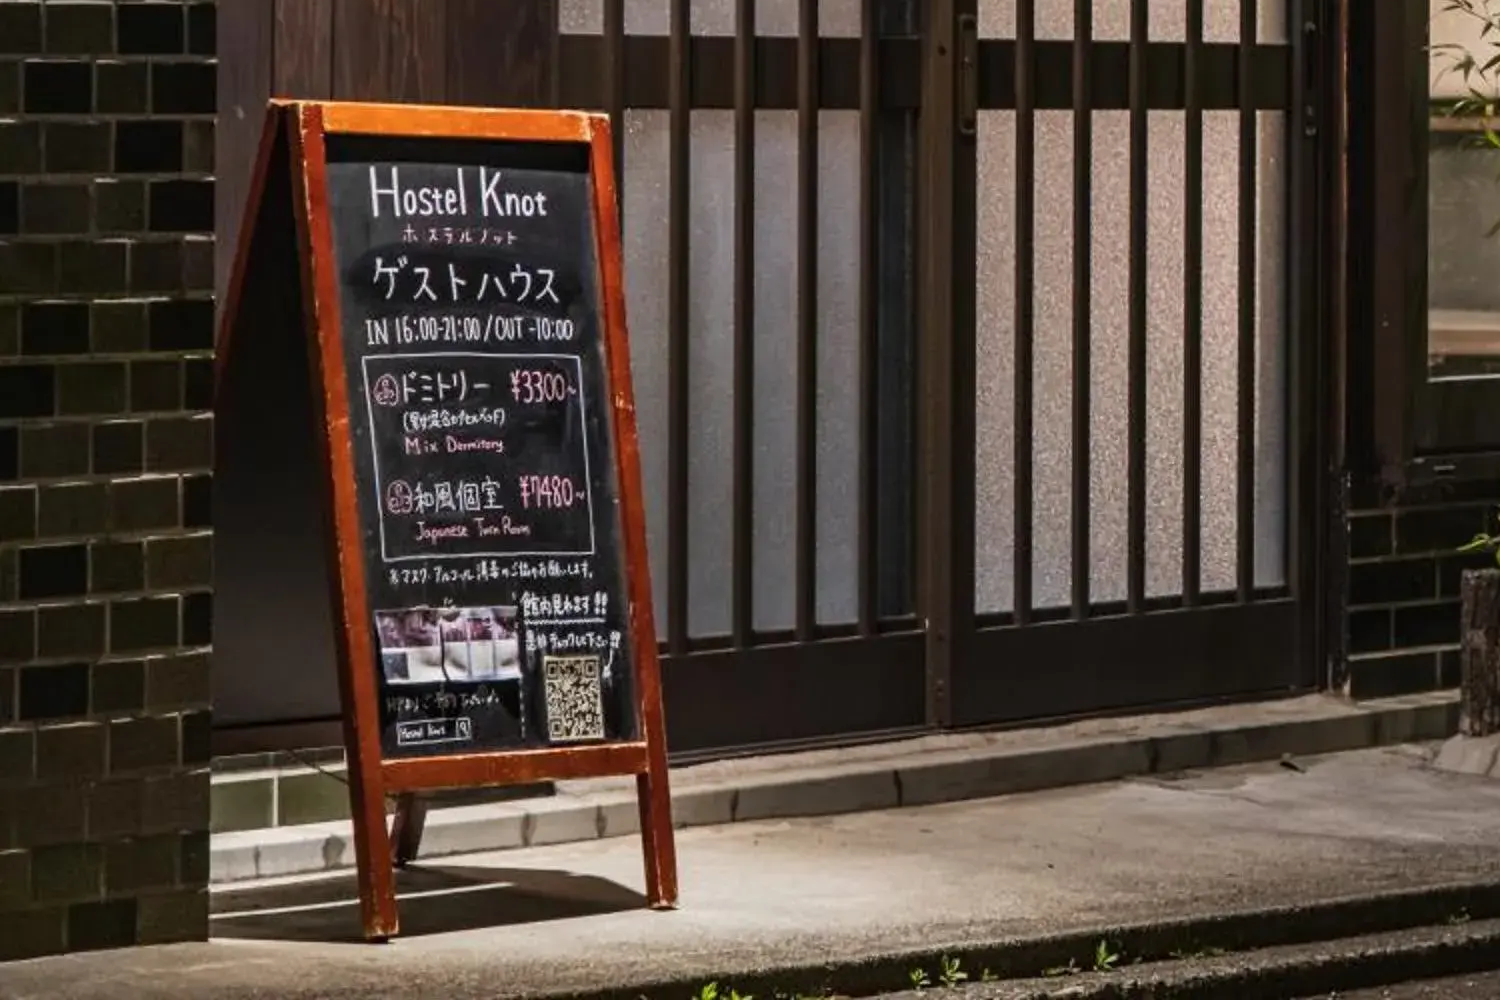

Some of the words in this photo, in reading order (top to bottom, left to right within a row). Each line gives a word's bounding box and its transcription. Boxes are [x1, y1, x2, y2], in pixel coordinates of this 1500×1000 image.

[369, 165, 468, 218] Hostel
[479, 166, 547, 218] Knot
[403, 223, 518, 245] ホステルノット
[372, 256, 560, 303] ゲストハウス
[365, 319, 389, 345] IN
[402, 369, 491, 404] ドミトリー
[404, 435, 438, 455] Mix
[446, 434, 504, 453] Dormitory
[414, 475, 504, 515] 和風個室
[415, 520, 470, 546] Japanese
[502, 514, 532, 538] Room
